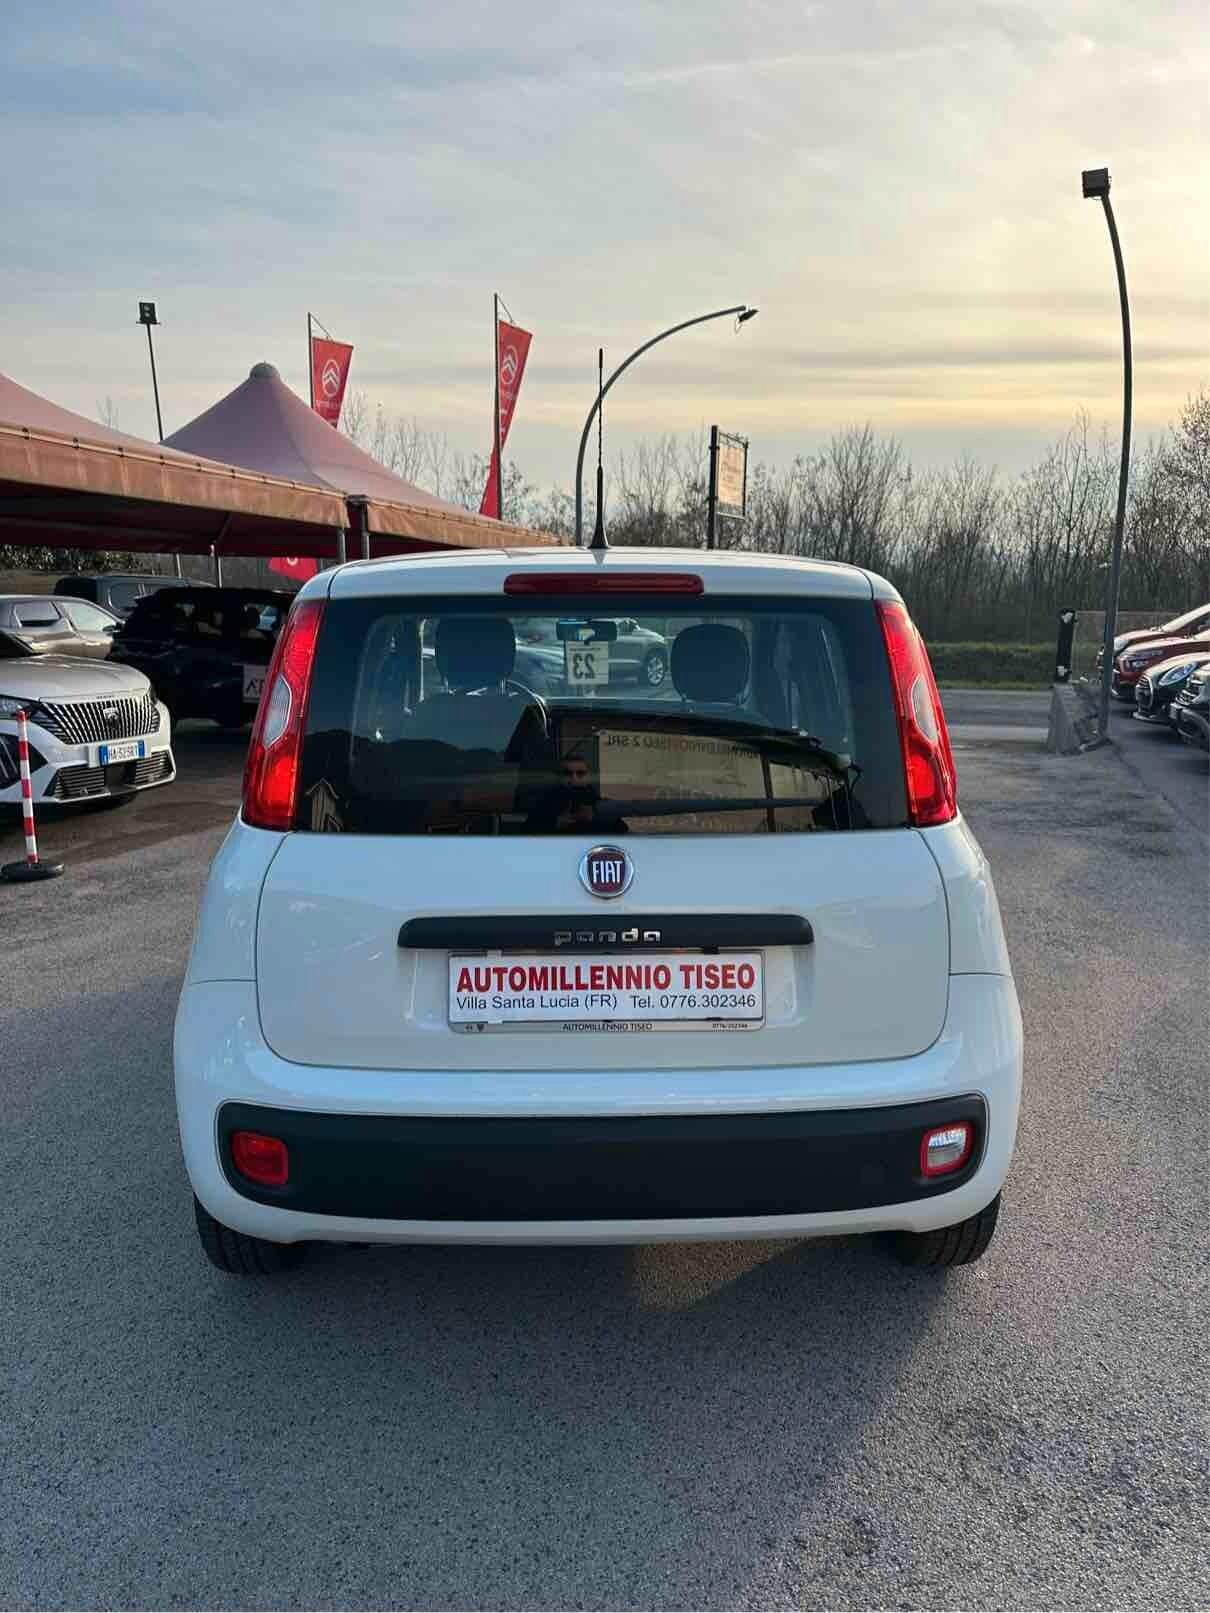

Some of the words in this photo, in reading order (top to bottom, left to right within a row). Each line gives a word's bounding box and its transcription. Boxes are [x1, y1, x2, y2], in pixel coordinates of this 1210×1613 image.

[592, 861, 623, 884] FIAT
[554, 928, 661, 946] panda
[457, 965, 671, 992] AUTOMILLENNIO
[680, 964, 755, 989] TISEO
[456, 996, 487, 1009] Villa
[492, 995, 535, 1009] Santa
[540, 994, 579, 1008] Lucia
[584, 993, 617, 1011] (FR)
[631, 995, 655, 1008] Tel.
[660, 994, 756, 1008] 0776.302346
